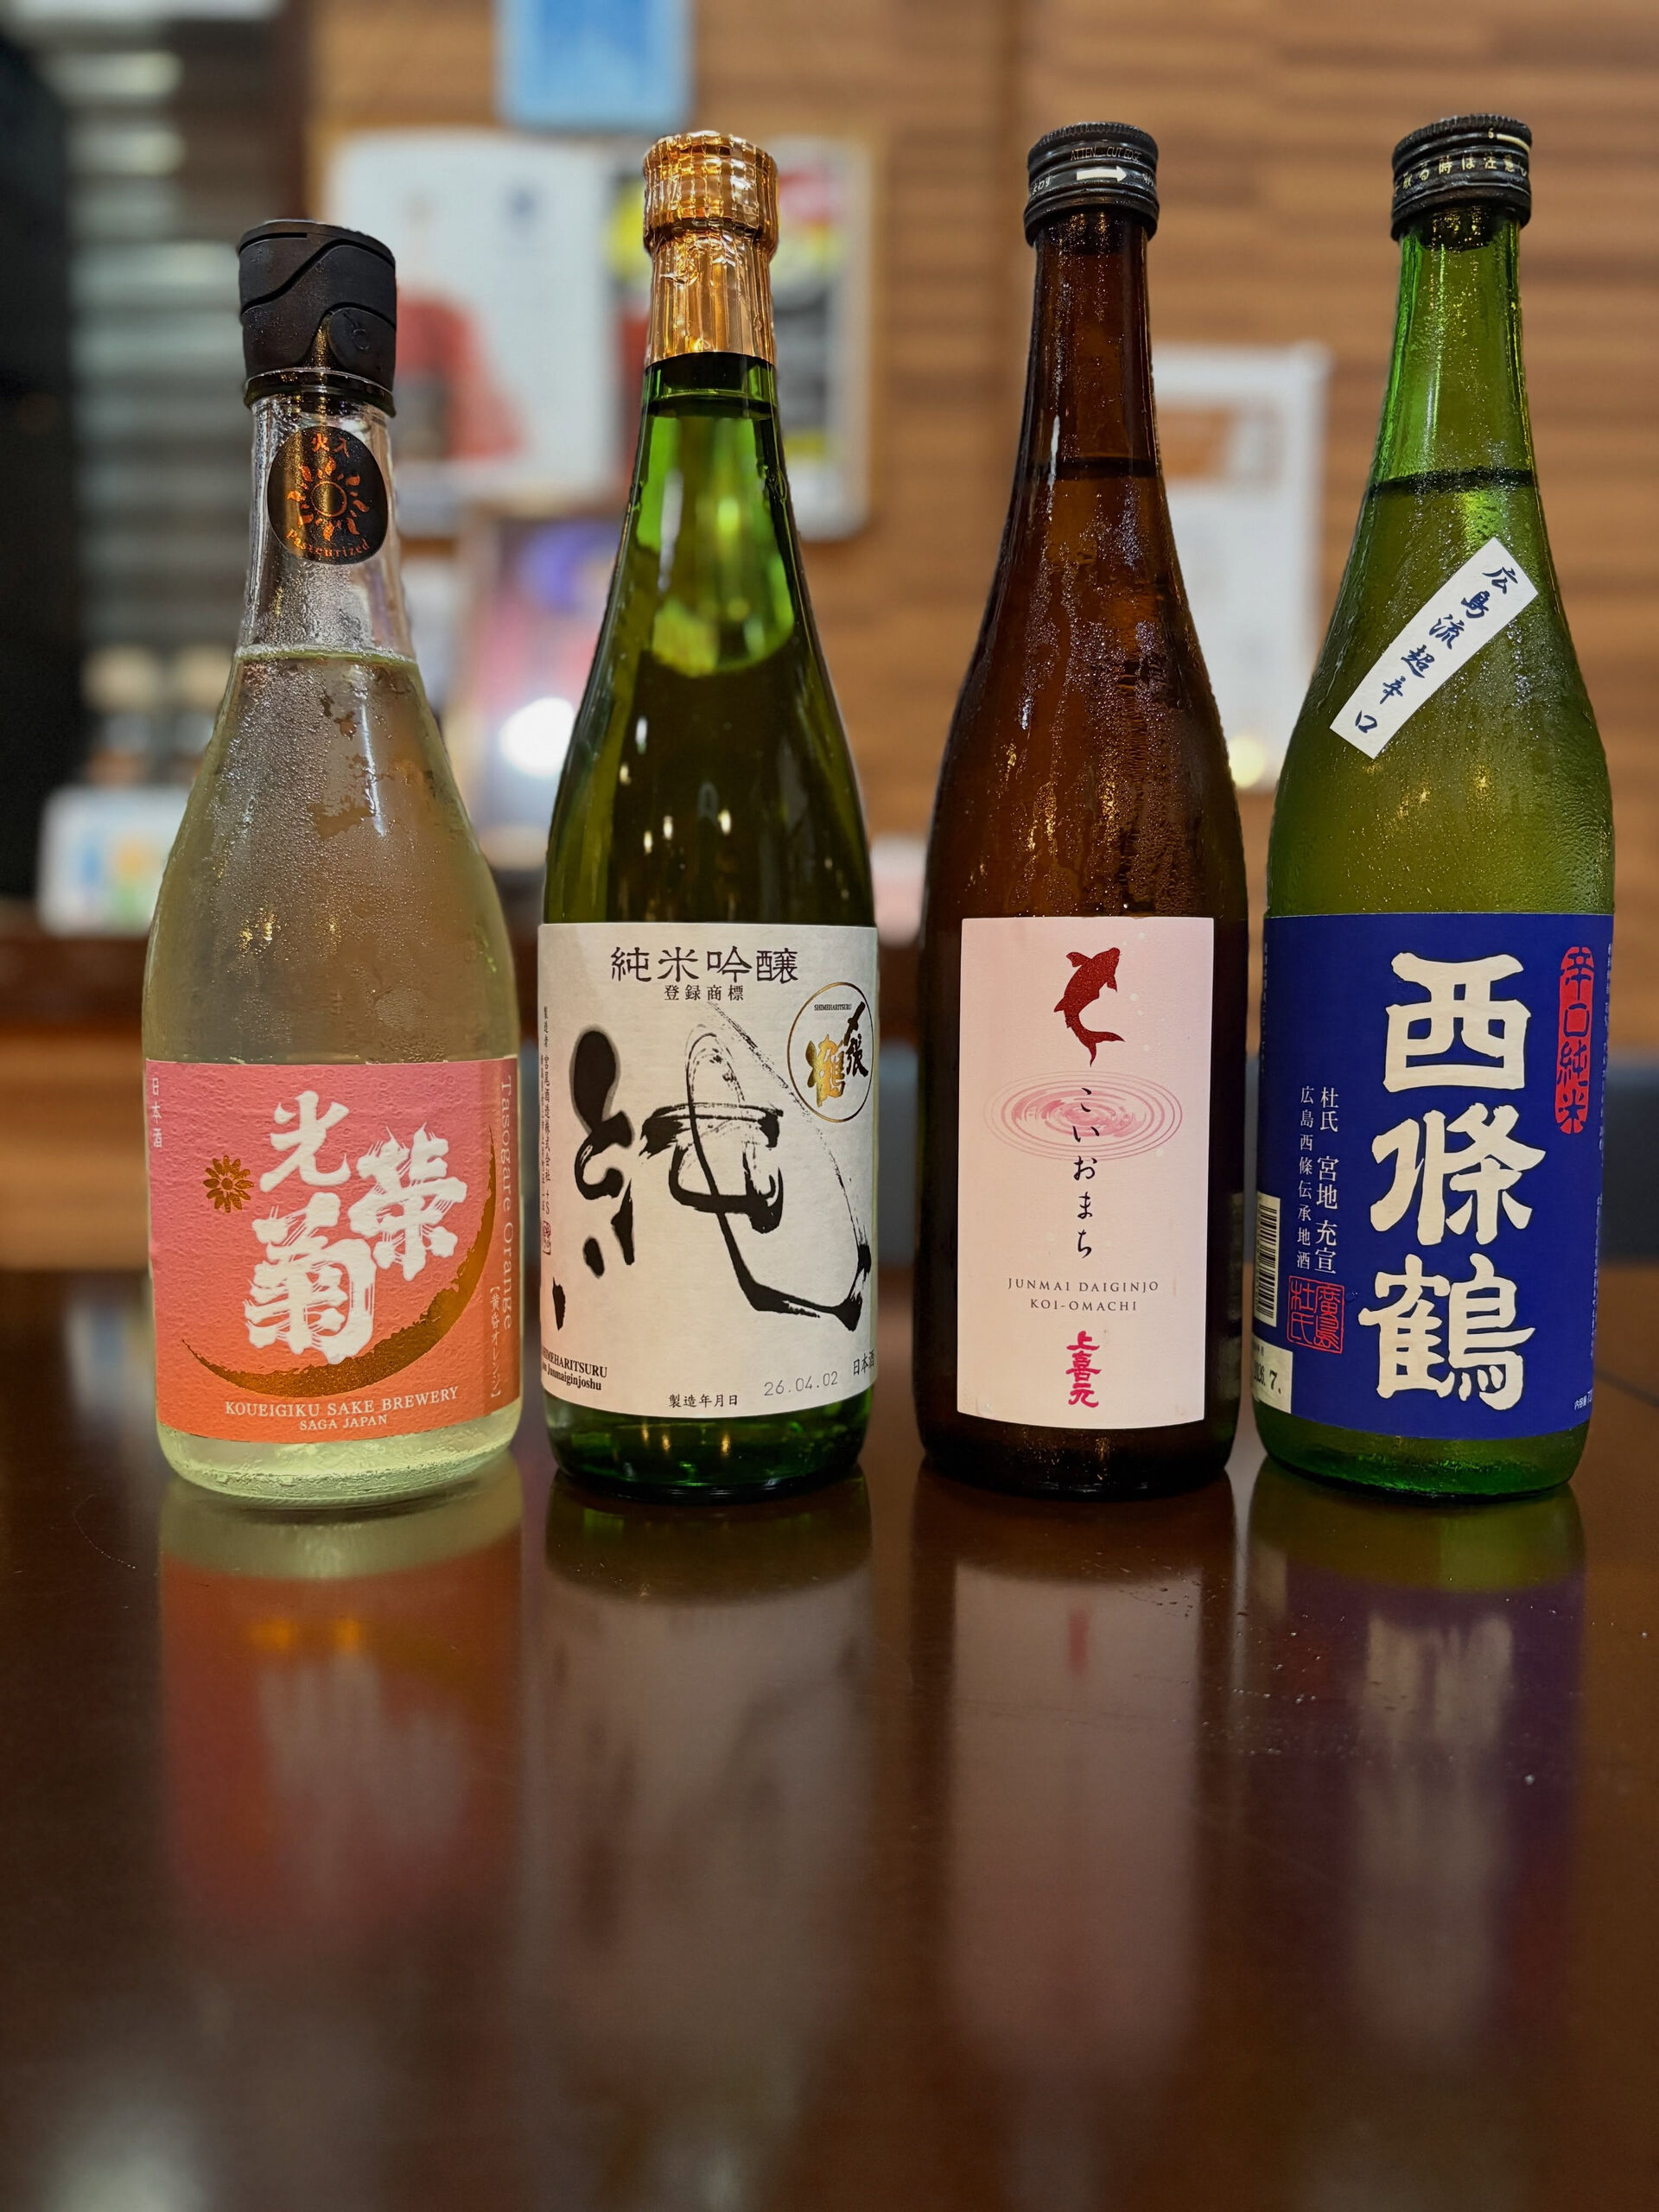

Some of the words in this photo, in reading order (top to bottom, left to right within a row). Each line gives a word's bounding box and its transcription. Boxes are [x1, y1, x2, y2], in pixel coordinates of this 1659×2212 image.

[1106, 146, 1122, 158] CUT
[311, 432, 351, 459] 火入
[285, 528, 371, 558] Pasteurized
[1354, 565, 1519, 734] 広島流超辛口
[610, 945, 799, 984] 純米吟醸
[664, 983, 745, 1001] 登録商標
[813, 1003, 852, 1012] SHIMEHARITSURU
[1556, 945, 1596, 1135] 辛口純米
[1319, 1086, 1340, 1134] 杜氏
[500, 1075, 512, 1211] Tasogare
[1071, 1086, 1101, 1260] こいおまち
[1296, 1086, 1316, 1270] 広島西條伝承地酒
[1316, 1155, 1339, 1211] 宮地
[1357, 951, 1547, 1411] 西條鶴
[1314, 1219, 1338, 1274] 充宣
[503, 1222, 515, 1330] Orange
[1007, 1277, 1071, 1293] JUNMAI
[1078, 1281, 1160, 1294] DAIGINJO
[1029, 1298, 1139, 1313] KOI-OMACHI
[764, 1370, 838, 1396] 26.04.02
[1065, 1329, 1103, 1408] 上喜元
[225, 1400, 321, 1420] KOUEIGIKU
[327, 1398, 375, 1415] SAKE
[381, 1386, 460, 1410] BREWERY
[668, 1393, 738, 1408] 製造年月日
[298, 1417, 340, 1432] SAGA
[342, 1414, 388, 1430] JAPAN
